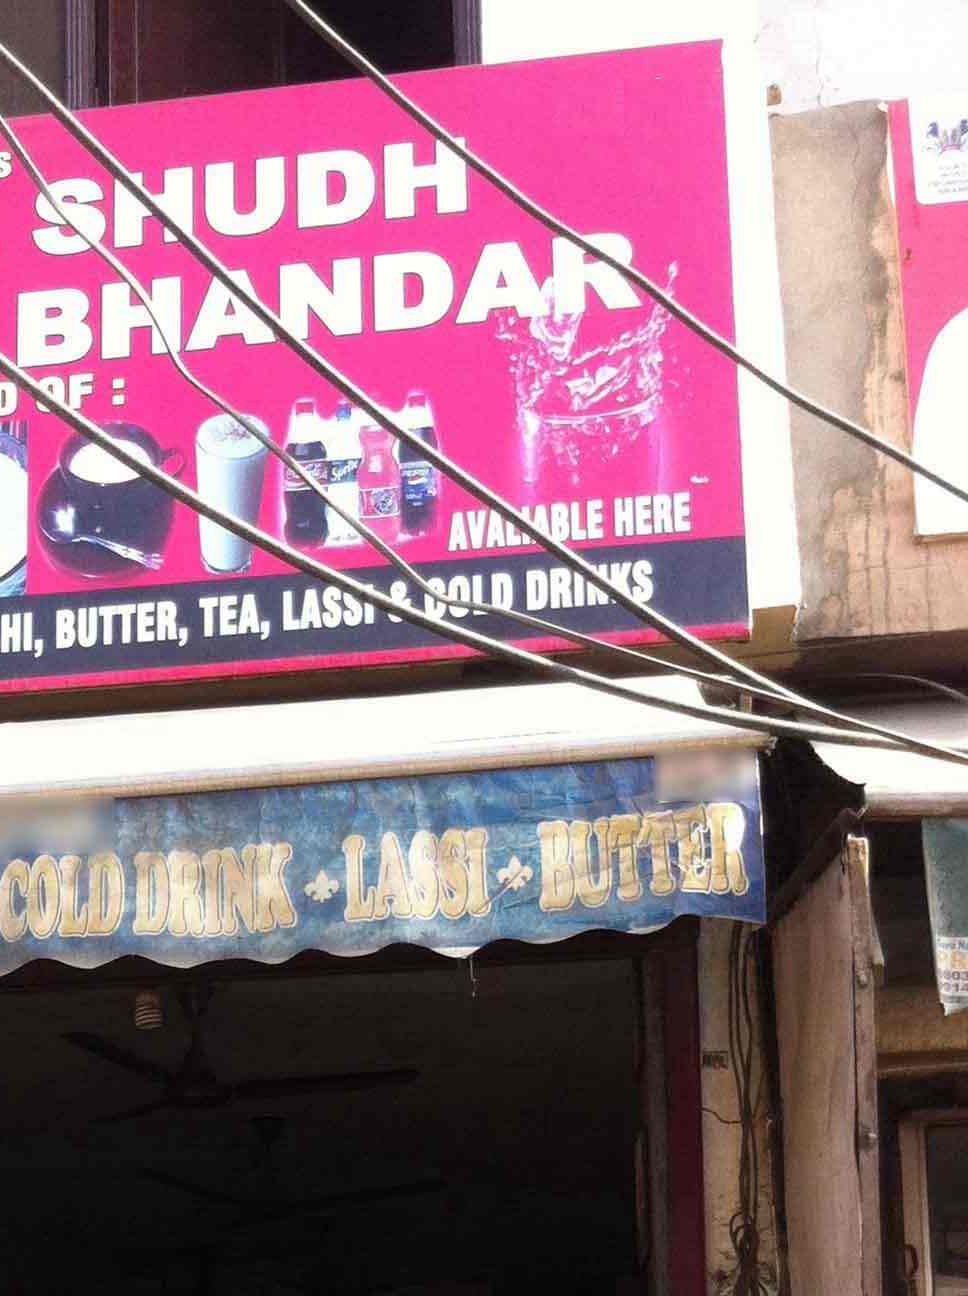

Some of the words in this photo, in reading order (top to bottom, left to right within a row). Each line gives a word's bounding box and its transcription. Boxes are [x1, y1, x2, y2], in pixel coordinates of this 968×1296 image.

[32, 137, 469, 255] SHUDH
[16, 232, 642, 368] BHANDAR
[614, 492, 690, 536] HERE
[56, 604, 188, 648] BUTTER,
[200, 594, 270, 639] TEA,
[281, 587, 374, 632] LASSI
[424, 571, 513, 619] COLD
[527, 561, 653, 611] DRINKS
[132, 842, 297, 937] DRINK
[342, 827, 491, 921] LASSI
[538, 802, 750, 912] BUTTER
